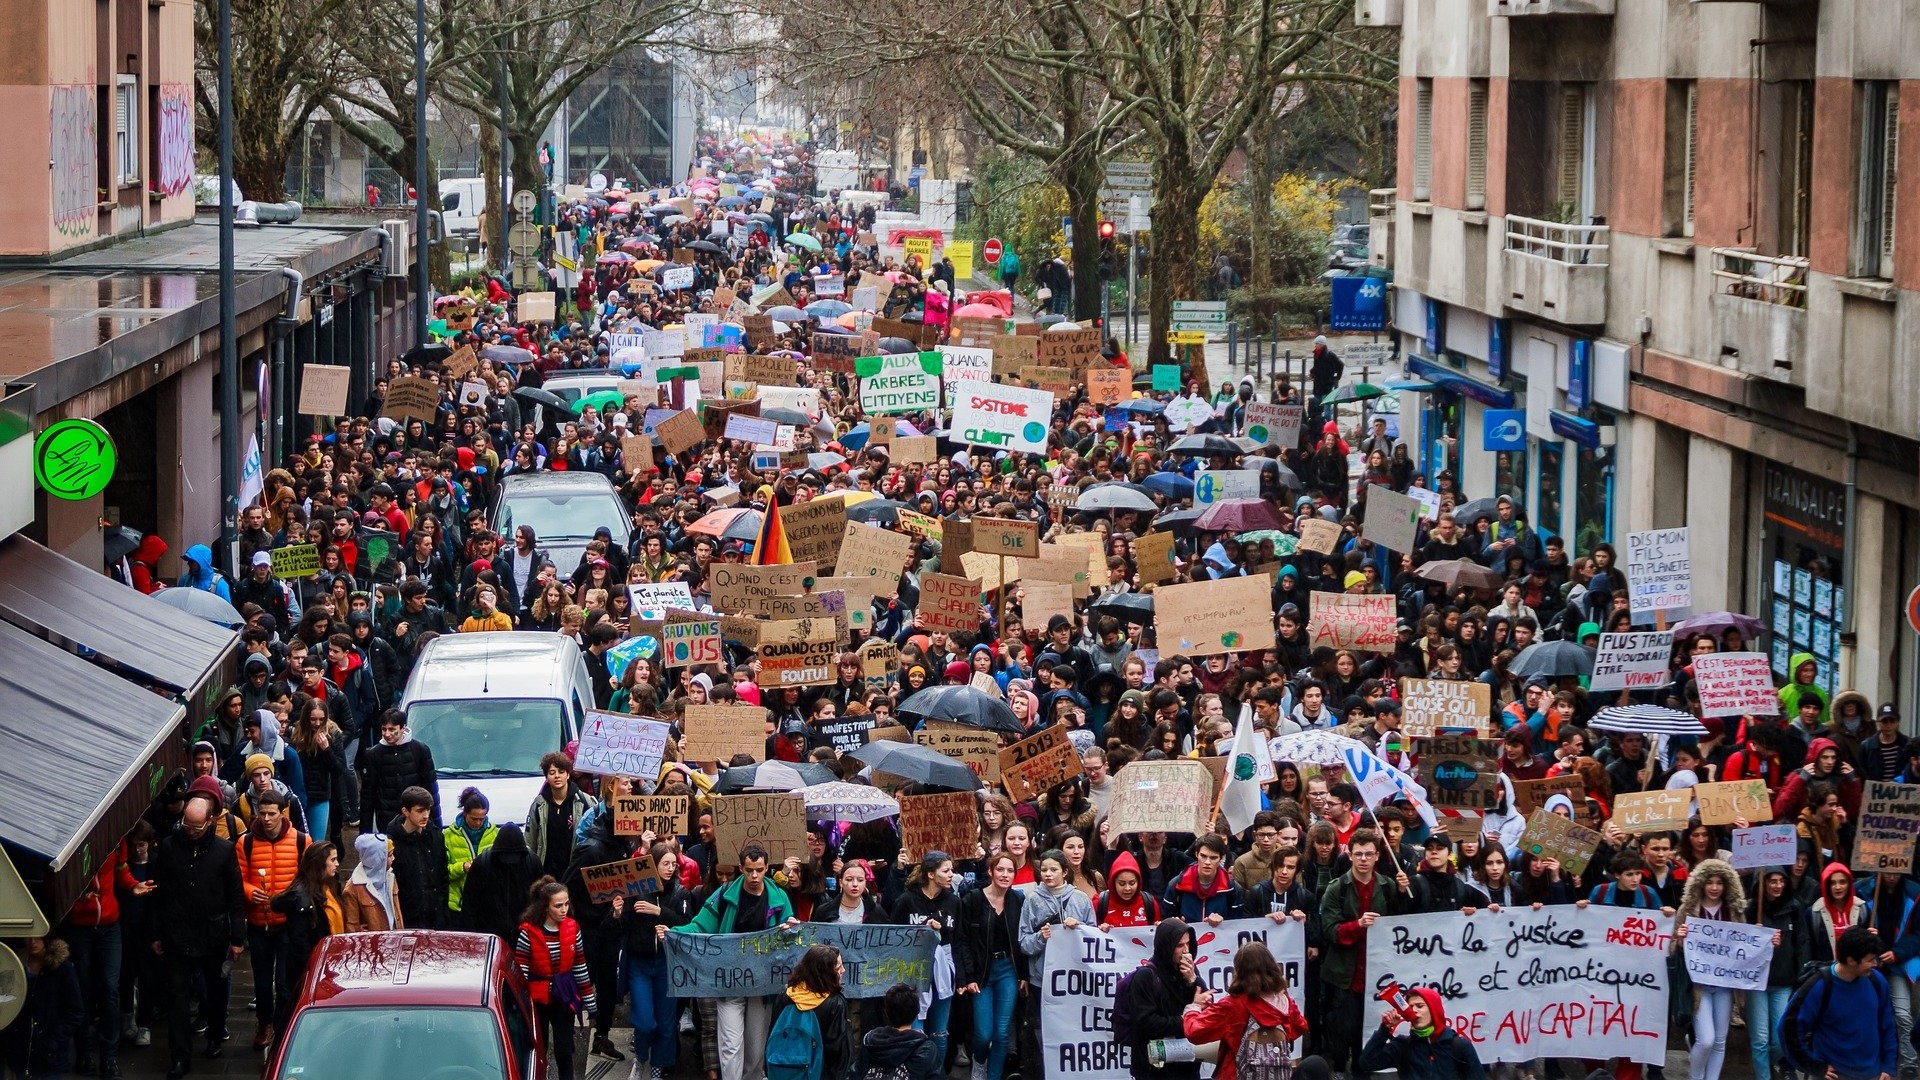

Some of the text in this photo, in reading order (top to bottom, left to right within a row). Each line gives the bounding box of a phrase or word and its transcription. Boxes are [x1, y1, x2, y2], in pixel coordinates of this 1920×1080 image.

[883, 356, 917, 368] AUX
[869, 374, 925, 390] ARBRES
[862, 391, 936, 408] CITOYENS
[1248, 403, 1301, 417] CLIMATE CHANGE
[1246, 414, 1266, 424] MADE
[1268, 417, 1280, 426] ME
[1281, 418, 1291, 427] DO
[1002, 535, 1025, 547] DIE
[1656, 529, 1686, 545] MON
[274, 550, 288, 560] PAS
[1629, 563, 1645, 575] TA
[716, 570, 798, 587] QUAND C'EST
[634, 586, 686, 600] Ta planète
[745, 586, 777, 597] FONDU
[924, 579, 970, 597] ON EST
[1637, 584, 1667, 596] BLEUE
[721, 595, 751, 609] C'EST
[773, 601, 820, 614] PAS DE
[938, 597, 976, 615] CHAUD
[922, 611, 956, 626] QUE LE
[665, 622, 719, 639] SAUVONS
[1315, 623, 1355, 648] AU
[763, 641, 835, 657] QUAND C'EST
[1601, 634, 1673, 649] PLUS TARD
[761, 654, 833, 670] FONDUE C'EST
[1596, 650, 1670, 664] JE VOUDRAIS
[781, 667, 828, 682] FOUTU!
[1625, 671, 1664, 686] VIVANT
[1728, 669, 1738, 677] DE
[1407, 680, 1469, 700] LA SEULE
[1405, 696, 1475, 715] CHOSE QUI
[612, 719, 651, 733] ÇA VA
[1405, 710, 1491, 730] DOIT FONDRE
[606, 734, 664, 755] CHAUFFER
[832, 734, 860, 744] POUR LE
[583, 746, 662, 775] RÉAGISSEZ
[1871, 783, 1917, 800] HAUT
[618, 798, 687, 815] TOUS DANS LA
[1868, 802, 1886, 813] LES
[615, 815, 680, 835] MÊME MERDE
[747, 824, 770, 838] ON
[1879, 854, 1909, 868] BAIN
[587, 859, 650, 880] ARRÊTE DE
[626, 877, 657, 895] MER
[1623, 917, 1657, 933] ZAD
[840, 927, 927, 950] VIEILLESSE
[1392, 914, 1588, 958] Pour la justice
[1605, 928, 1672, 951] PARTOUT
[1702, 925, 1723, 939] QUI
[1727, 929, 1761, 948] RISQUE
[1082, 937, 1116, 963] ILS
[672, 965, 754, 988] ON AURA
[1479, 957, 1661, 1004] et climatique
[1082, 1006, 1113, 1032] LES
[1496, 994, 1658, 1044] AU CAPITAL
